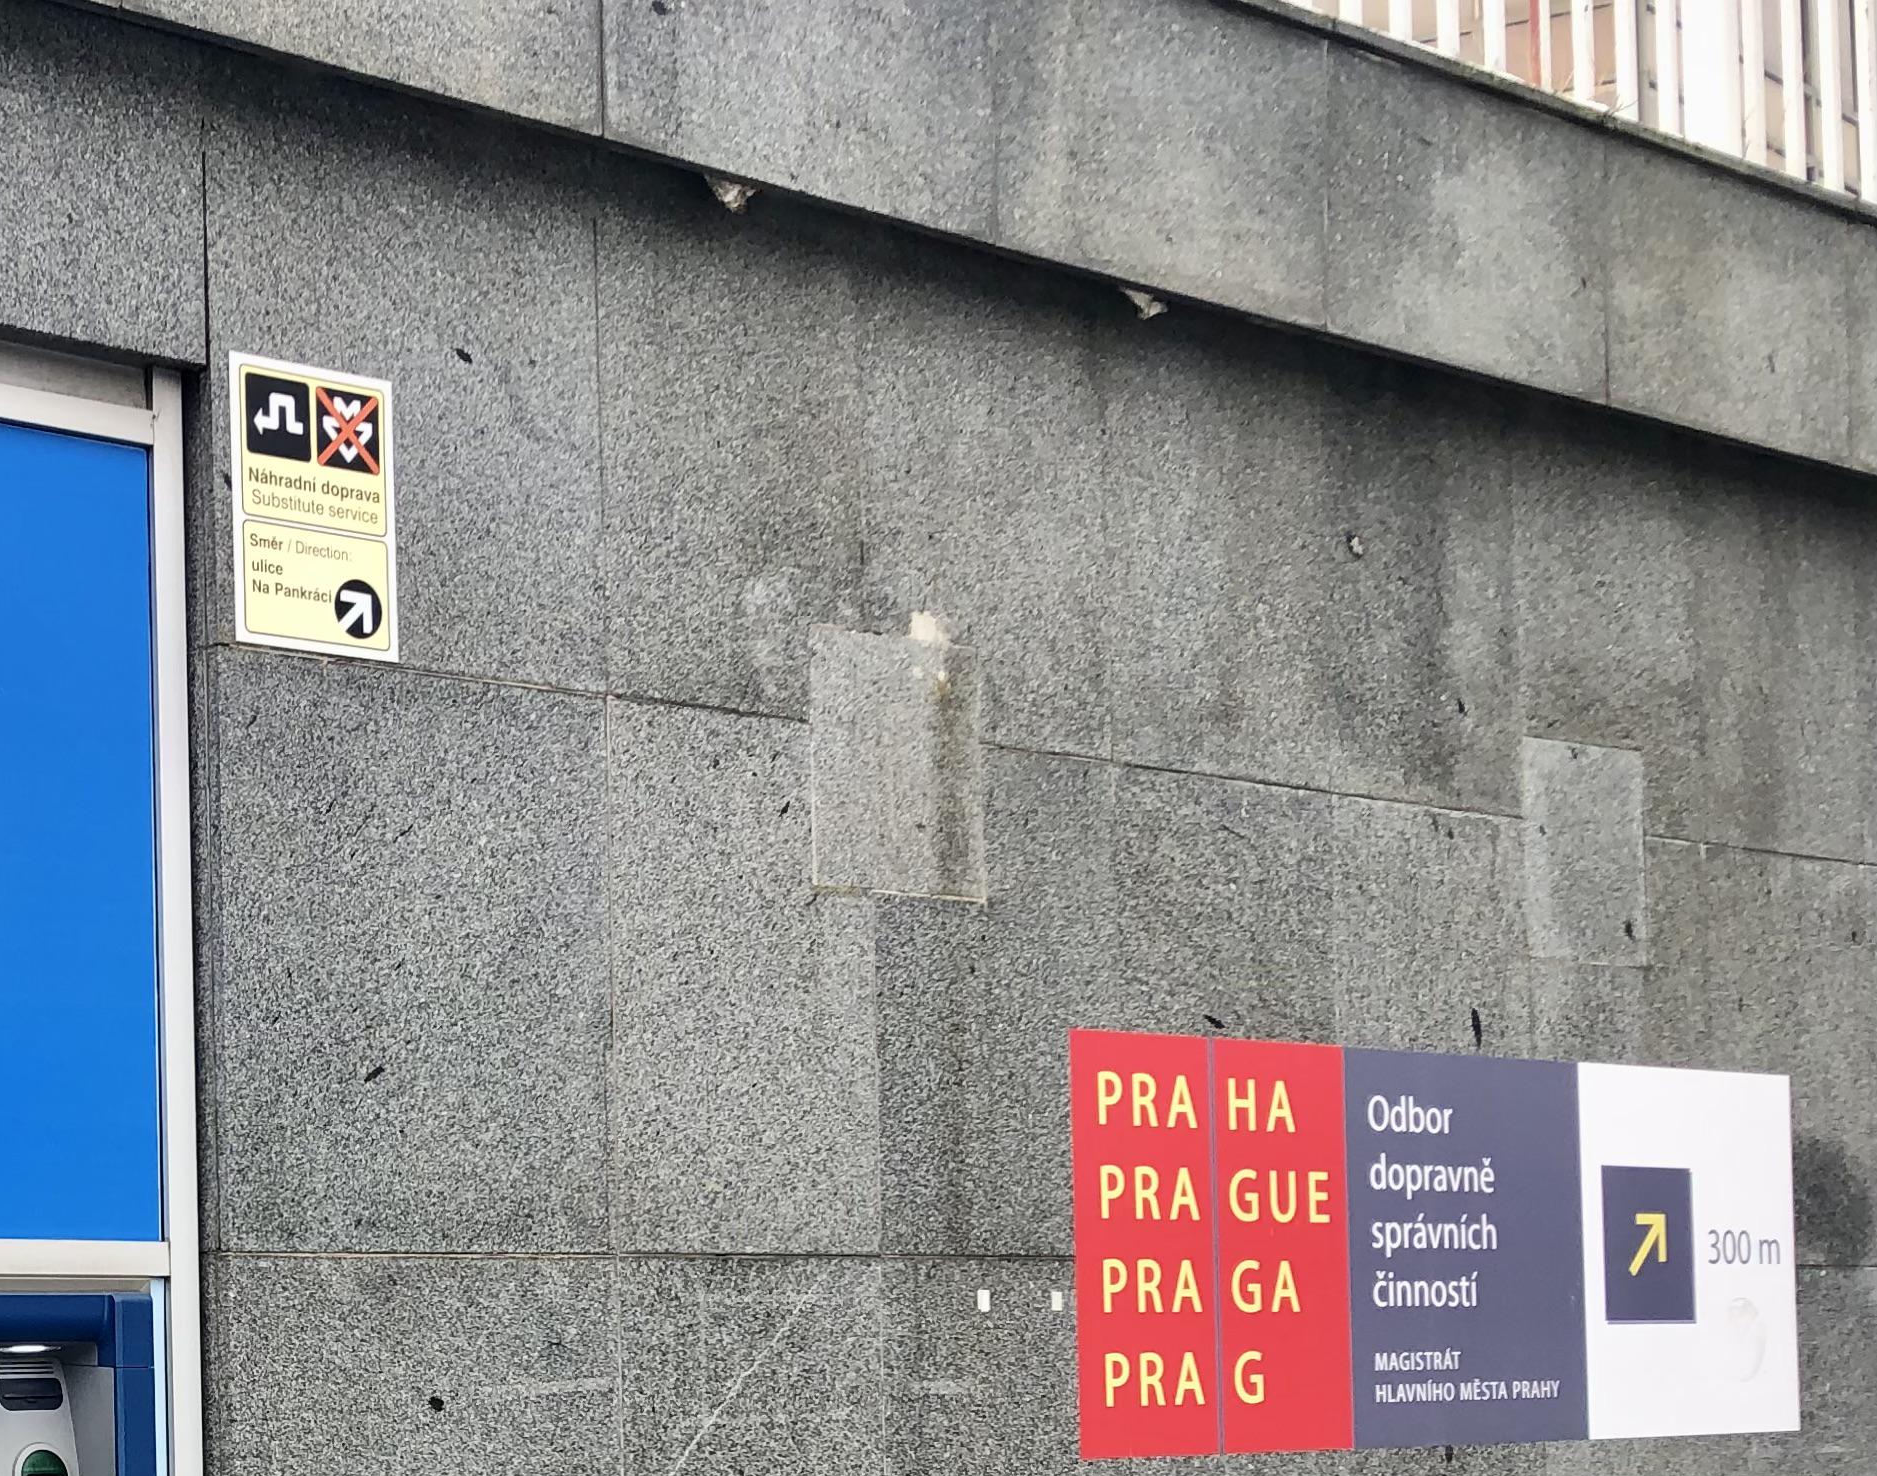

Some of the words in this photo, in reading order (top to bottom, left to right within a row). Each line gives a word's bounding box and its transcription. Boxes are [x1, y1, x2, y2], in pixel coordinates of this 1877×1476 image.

[248, 466, 316, 492] Náhradní
[321, 481, 380, 503] doprava
[252, 489, 324, 515] Substitute
[328, 505, 379, 524] service
[250, 533, 283, 551] Směr
[295, 540, 353, 562] Direction:
[252, 559, 283, 575] ulice
[252, 578, 270, 594] Na
[275, 582, 332, 603] Pankráci
[1097, 1071, 1198, 1129] PRA
[1227, 1077, 1296, 1133] HA
[1367, 1095, 1453, 1134] Odbor
[1100, 1164, 1201, 1221] PRA
[1229, 1168, 1331, 1224] GUE
[1369, 1153, 1495, 1200] dopravně
[1371, 1212, 1498, 1257] správních
[1708, 1229, 1751, 1264] 300
[1759, 1239, 1780, 1264] m
[1102, 1258, 1203, 1313] PRA
[1231, 1259, 1301, 1313] GA
[1373, 1270, 1478, 1307] činností
[1374, 1348, 1462, 1371] MAGISTRÁT
[1104, 1352, 1206, 1408] PRA
[1234, 1350, 1265, 1404] G
[1375, 1379, 1455, 1403] HLAVNÍHO
[1459, 1379, 1508, 1400] MĚSTA
[1512, 1380, 1560, 1399] PRAHY
